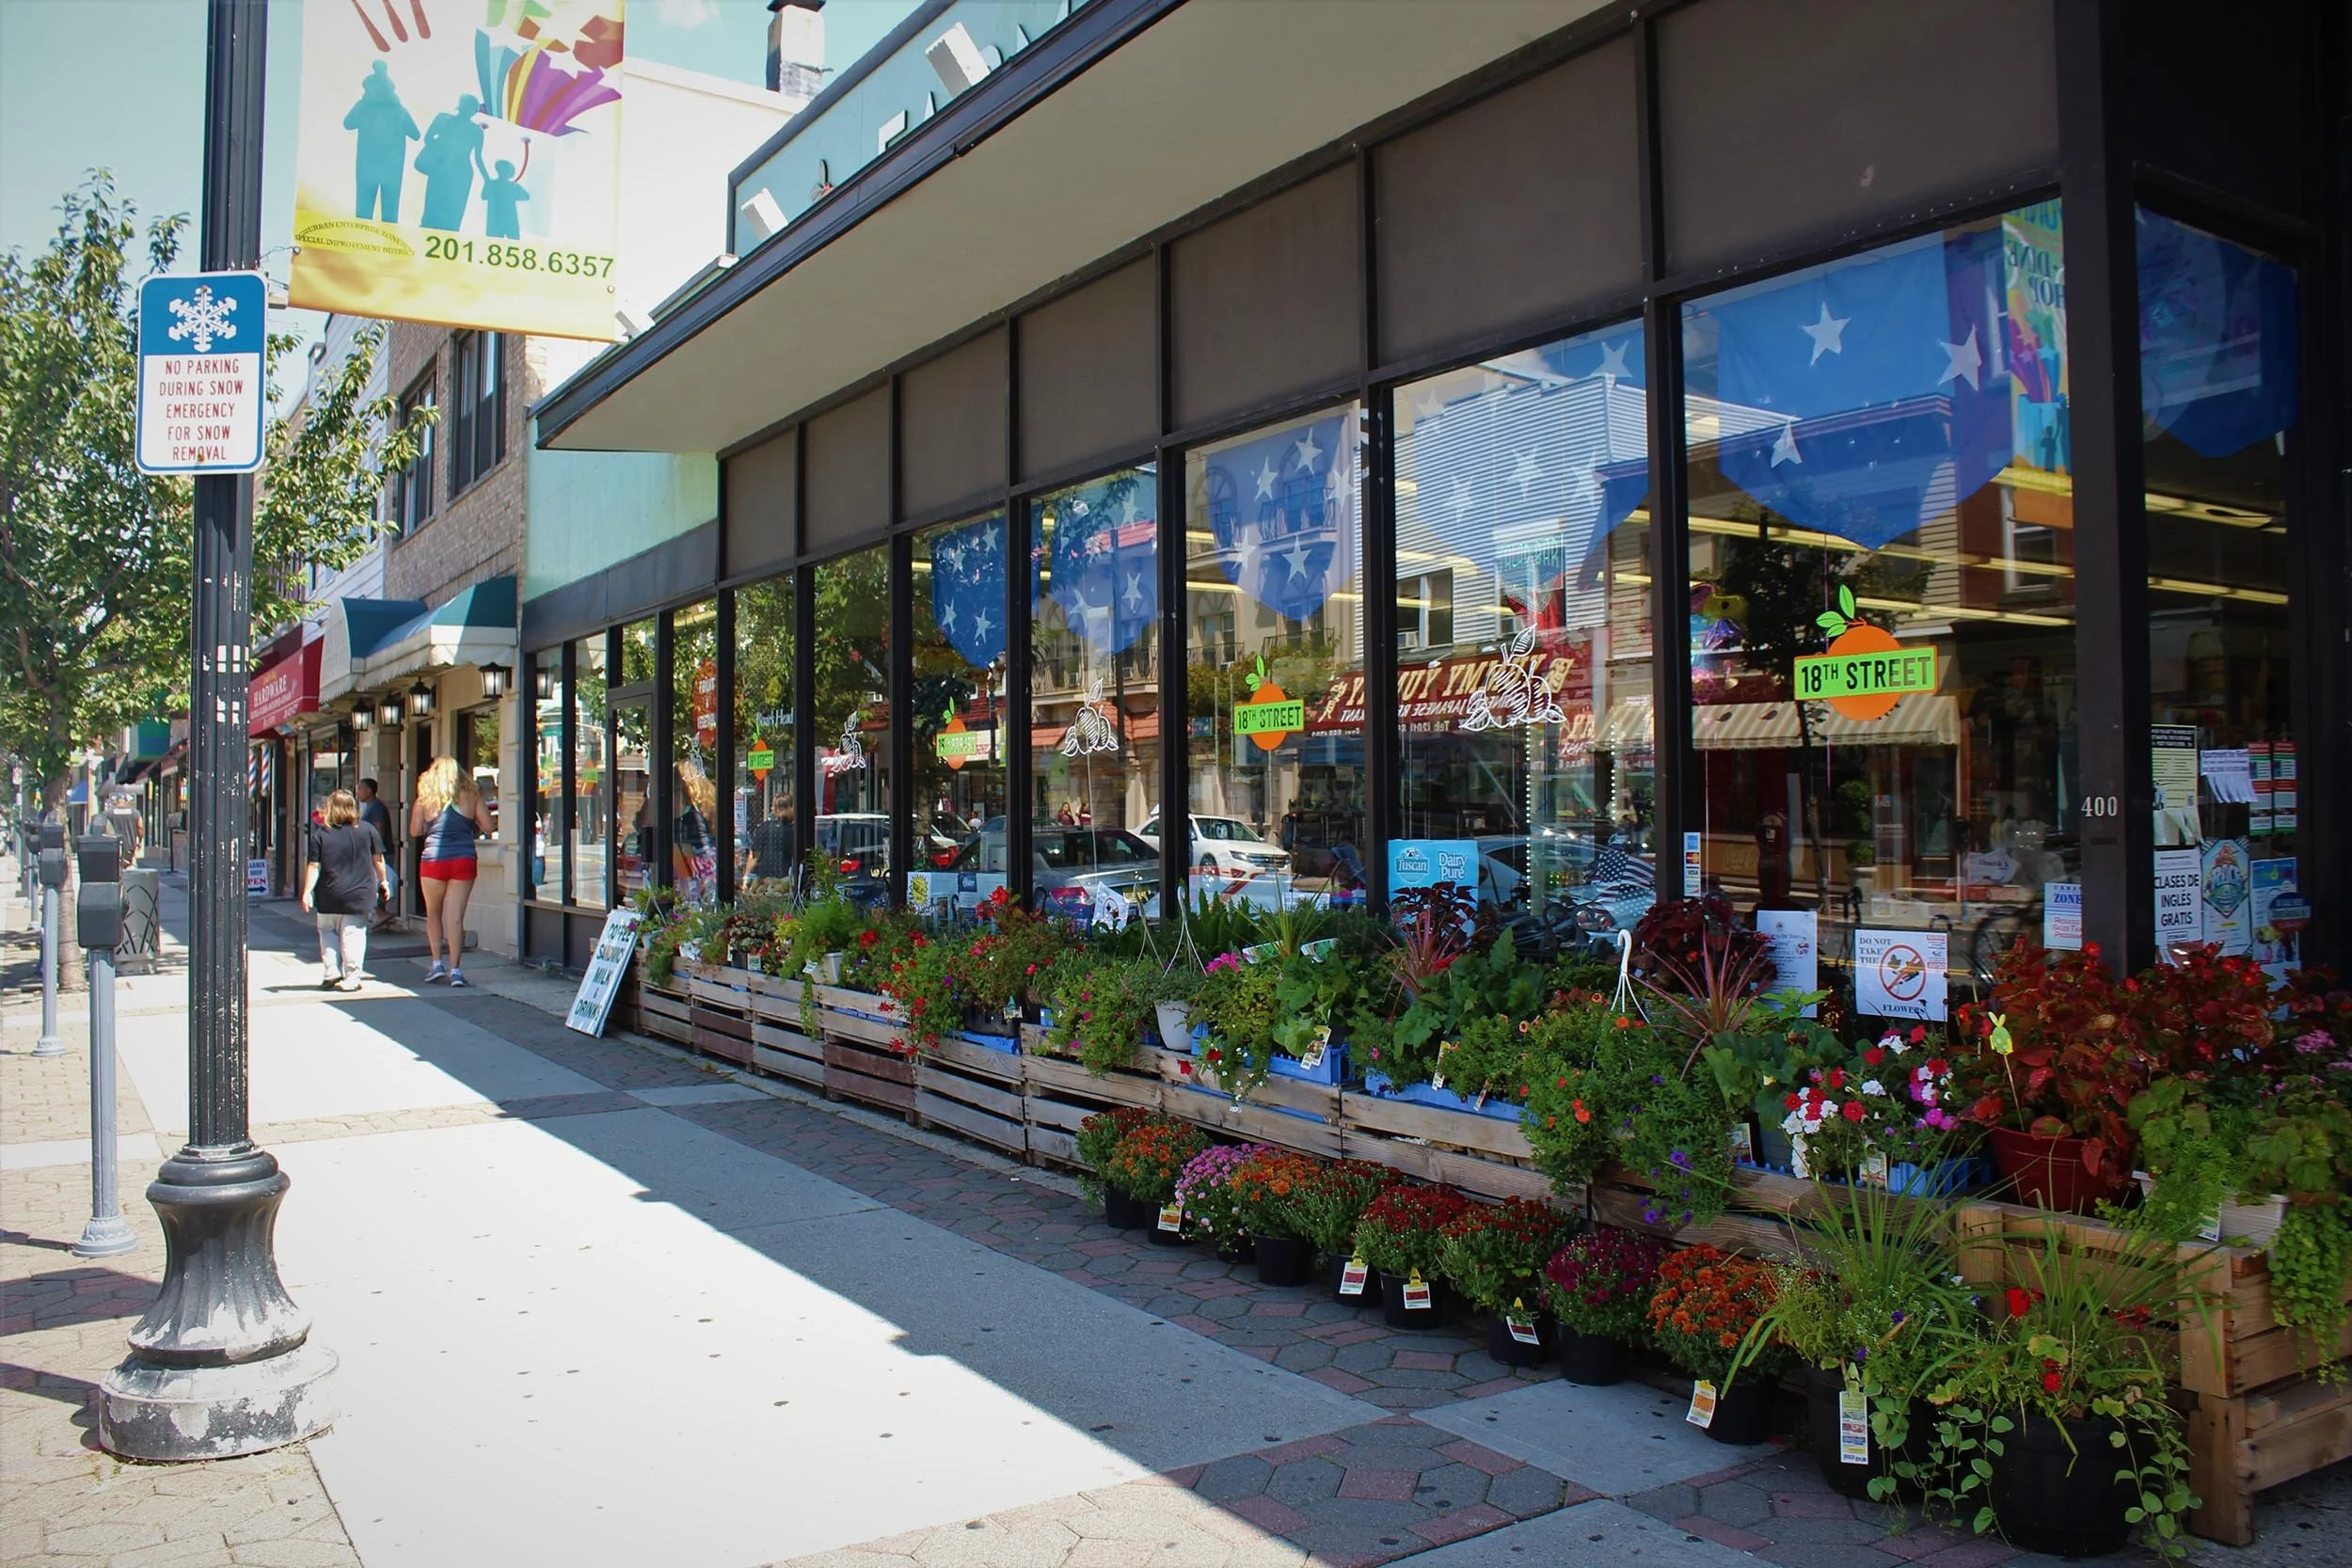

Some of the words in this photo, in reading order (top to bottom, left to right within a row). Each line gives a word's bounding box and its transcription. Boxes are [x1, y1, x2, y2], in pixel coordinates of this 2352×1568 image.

[308, 221, 334, 232] URBAN
[424, 235, 614, 278] 201.858.6357
[165, 360, 181, 374] NO
[187, 358, 239, 374] PARKING
[159, 381, 203, 396] DURING
[210, 380, 243, 395] SNOW
[166, 403, 235, 419] EMERGENCY
[167, 426, 190, 440] FOR
[197, 425, 230, 440] SNOW
[172, 446, 226, 461] REMOVAL
[1801, 662, 1838, 693] 18TH
[1846, 656, 1931, 689] STREET
[253, 673, 288, 708] HARDWARE
[776, 707, 794, 729] Head
[1237, 709, 1257, 730] 18TH
[1259, 705, 1301, 728] STREET
[2080, 796, 2118, 817] 400
[1397, 858, 1428, 872] Tuscan
[1438, 851, 1468, 869] Dairy
[1441, 865, 1465, 880] Pure
[2153, 875, 2186, 890] CLASES
[2188, 874, 2200, 887] DE
[2054, 894, 2083, 904] ZONE
[2161, 890, 2192, 908] INGLÉS
[2161, 911, 2193, 927] GRATIS
[1859, 937, 1872, 945] DO
[1873, 937, 1892, 946] NOT
[1858, 946, 1883, 956] TAKE
[593, 966, 613, 987] MILK
[1883, 1004, 1926, 1014] FLOWERS
